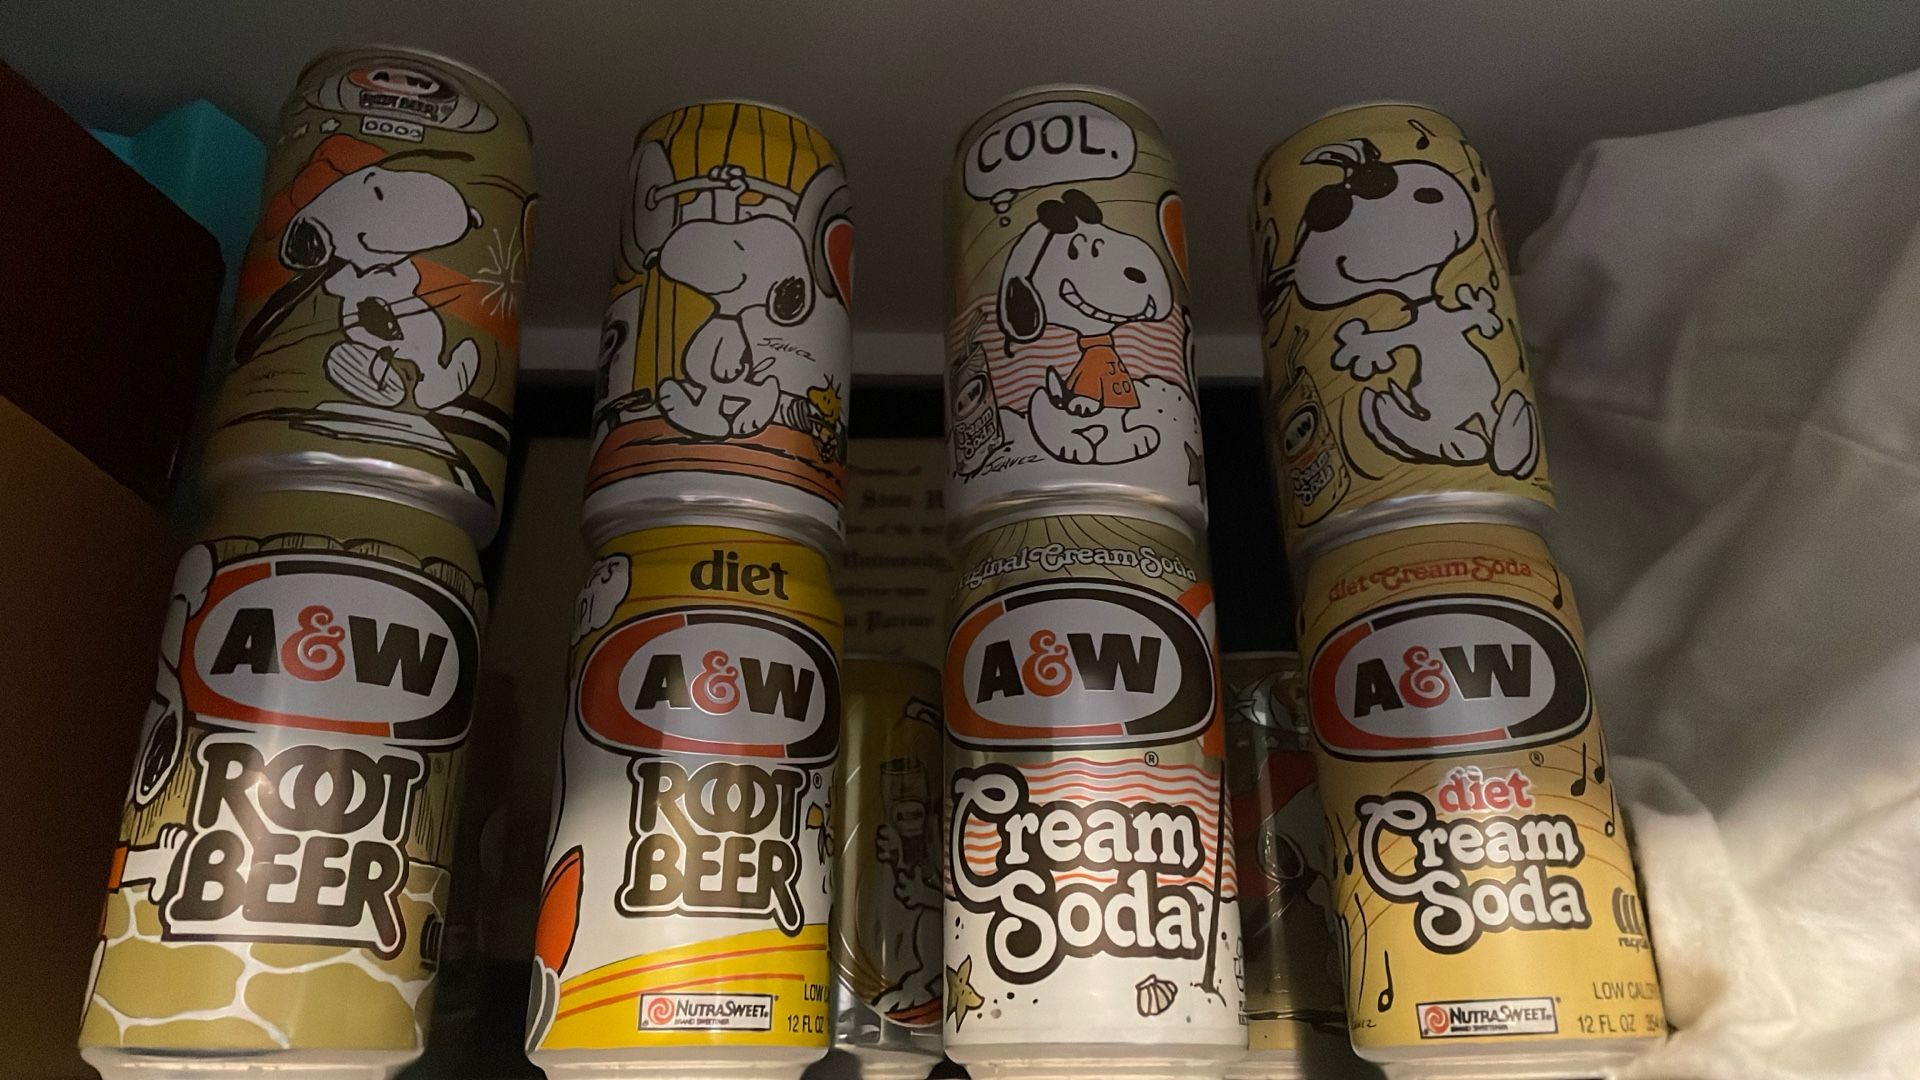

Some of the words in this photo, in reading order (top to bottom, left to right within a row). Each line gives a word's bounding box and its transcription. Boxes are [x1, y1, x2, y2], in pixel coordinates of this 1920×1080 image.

[977, 114, 1119, 173] COOL.
[690, 550, 789, 600] diet
[1029, 543, 1138, 572] Cream
[1139, 545, 1198, 584] Soda
[1329, 577, 1369, 602] diet
[1369, 560, 1467, 591] Cream
[1472, 556, 1532, 582] Soda
[210, 605, 448, 697] A&W
[634, 650, 815, 722] A&W
[976, 629, 1162, 704] A&W
[1353, 645, 1532, 718] A&W
[202, 740, 424, 842] ROOT
[637, 761, 802, 840] ROOT
[1438, 765, 1534, 812] diet
[953, 769, 1201, 904] Cream
[1360, 798, 1580, 896] Cream
[168, 830, 402, 950] BEER
[623, 833, 799, 929] BEER
[1420, 864, 1586, 947] Soda
[993, 868, 1199, 974] Soda
[787, 1015, 799, 1033] 12
[802, 1015, 813, 1033] FL
[815, 1015, 825, 1034] OZ
[804, 984, 824, 1001] LOW
[1578, 1015, 1595, 1033] 12
[1599, 1014, 1616, 1034] FL
[1620, 1014, 1636, 1033] OZ
[1592, 982, 1624, 1000] LOW
